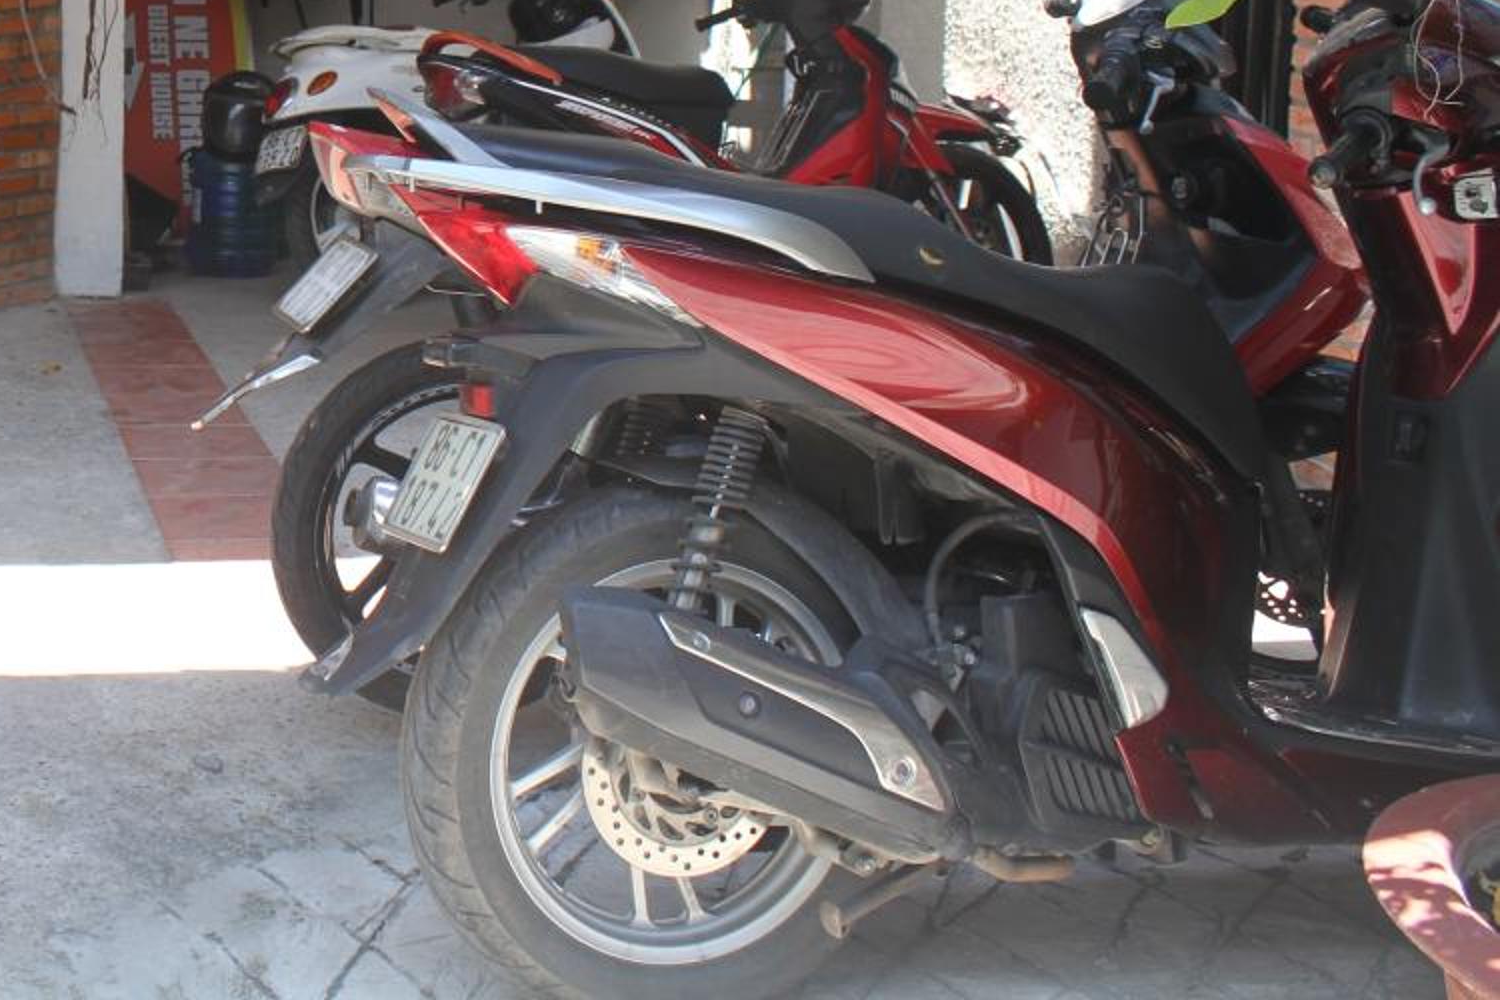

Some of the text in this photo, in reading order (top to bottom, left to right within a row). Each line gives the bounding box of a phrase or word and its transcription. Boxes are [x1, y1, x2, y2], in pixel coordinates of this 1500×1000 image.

[148, 5, 175, 139] GUEST HOUSE
[174, 16, 209, 59] NE
